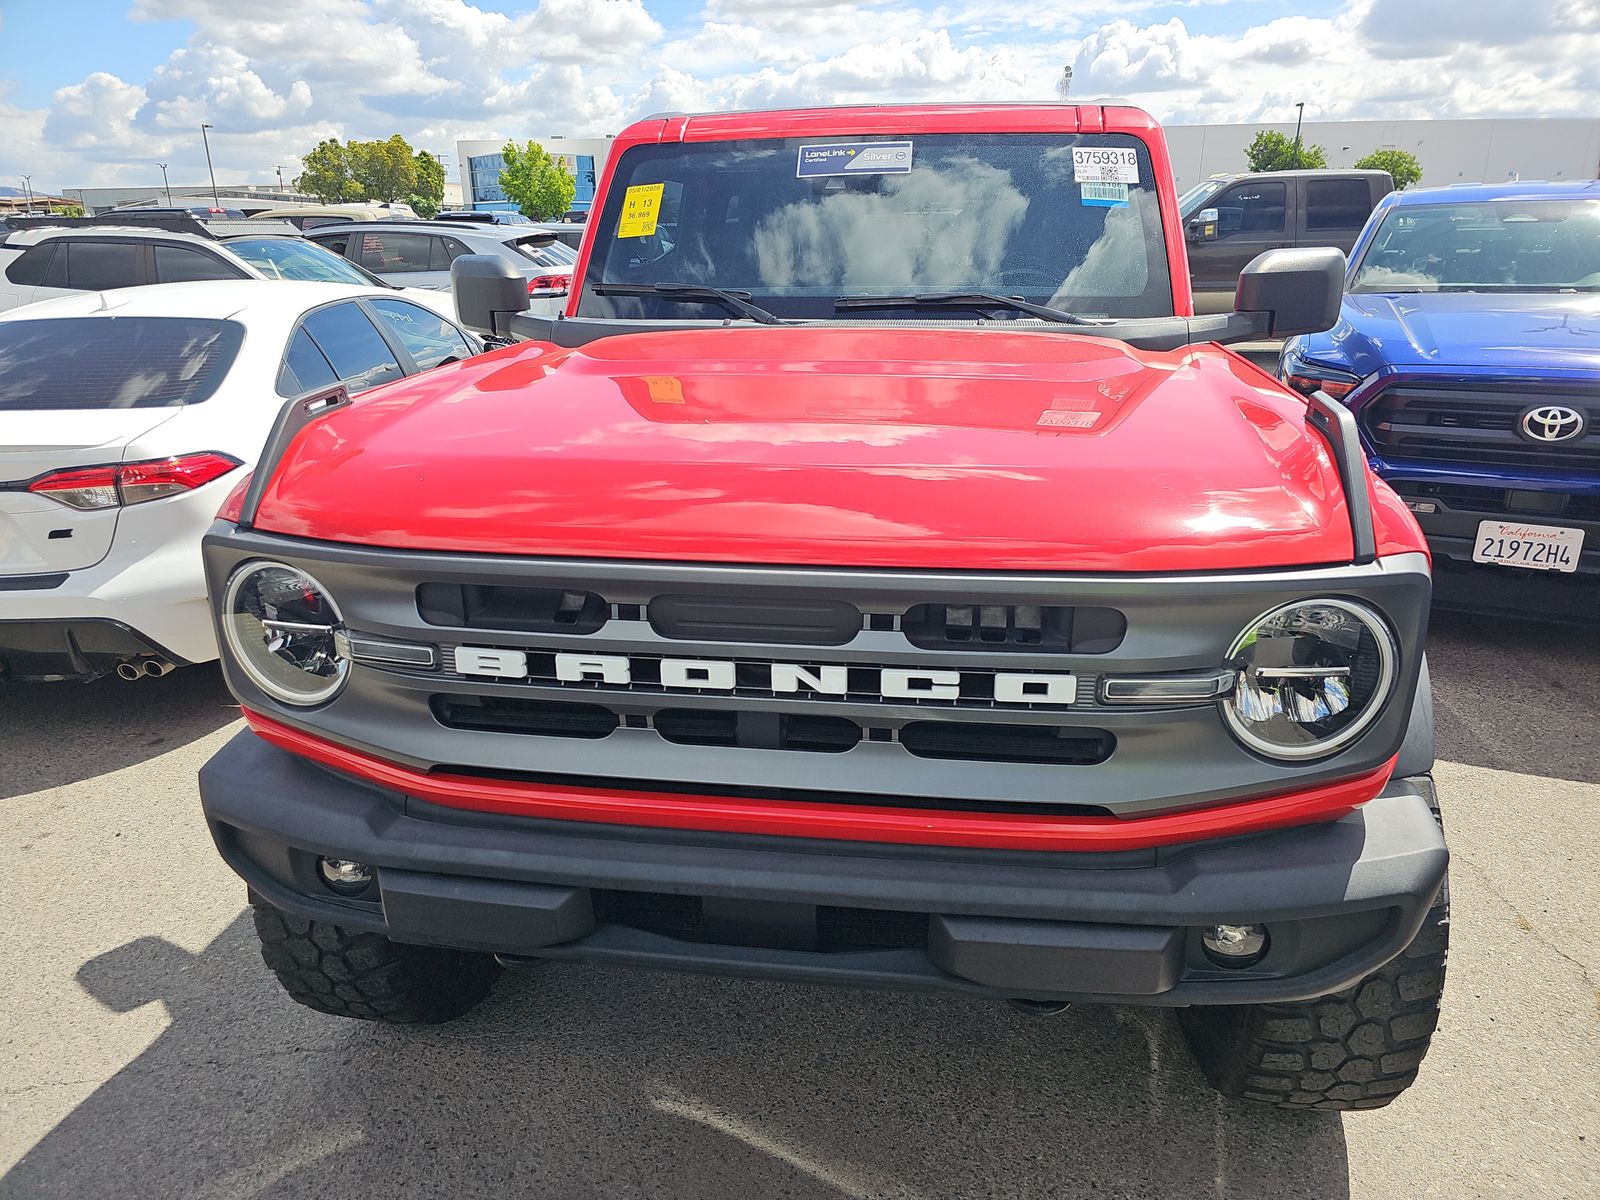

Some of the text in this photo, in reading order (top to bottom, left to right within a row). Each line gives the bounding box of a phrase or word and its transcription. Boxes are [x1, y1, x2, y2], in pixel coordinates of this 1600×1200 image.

[805, 149, 846, 158] LaneLink
[863, 152, 892, 160] Silver
[1075, 151, 1136, 165] 3759318
[629, 199, 653, 209] H 13
[1500, 525, 1560, 540] California
[1481, 537, 1570, 566] 21972H4
[454, 645, 1077, 705] BRONCO
